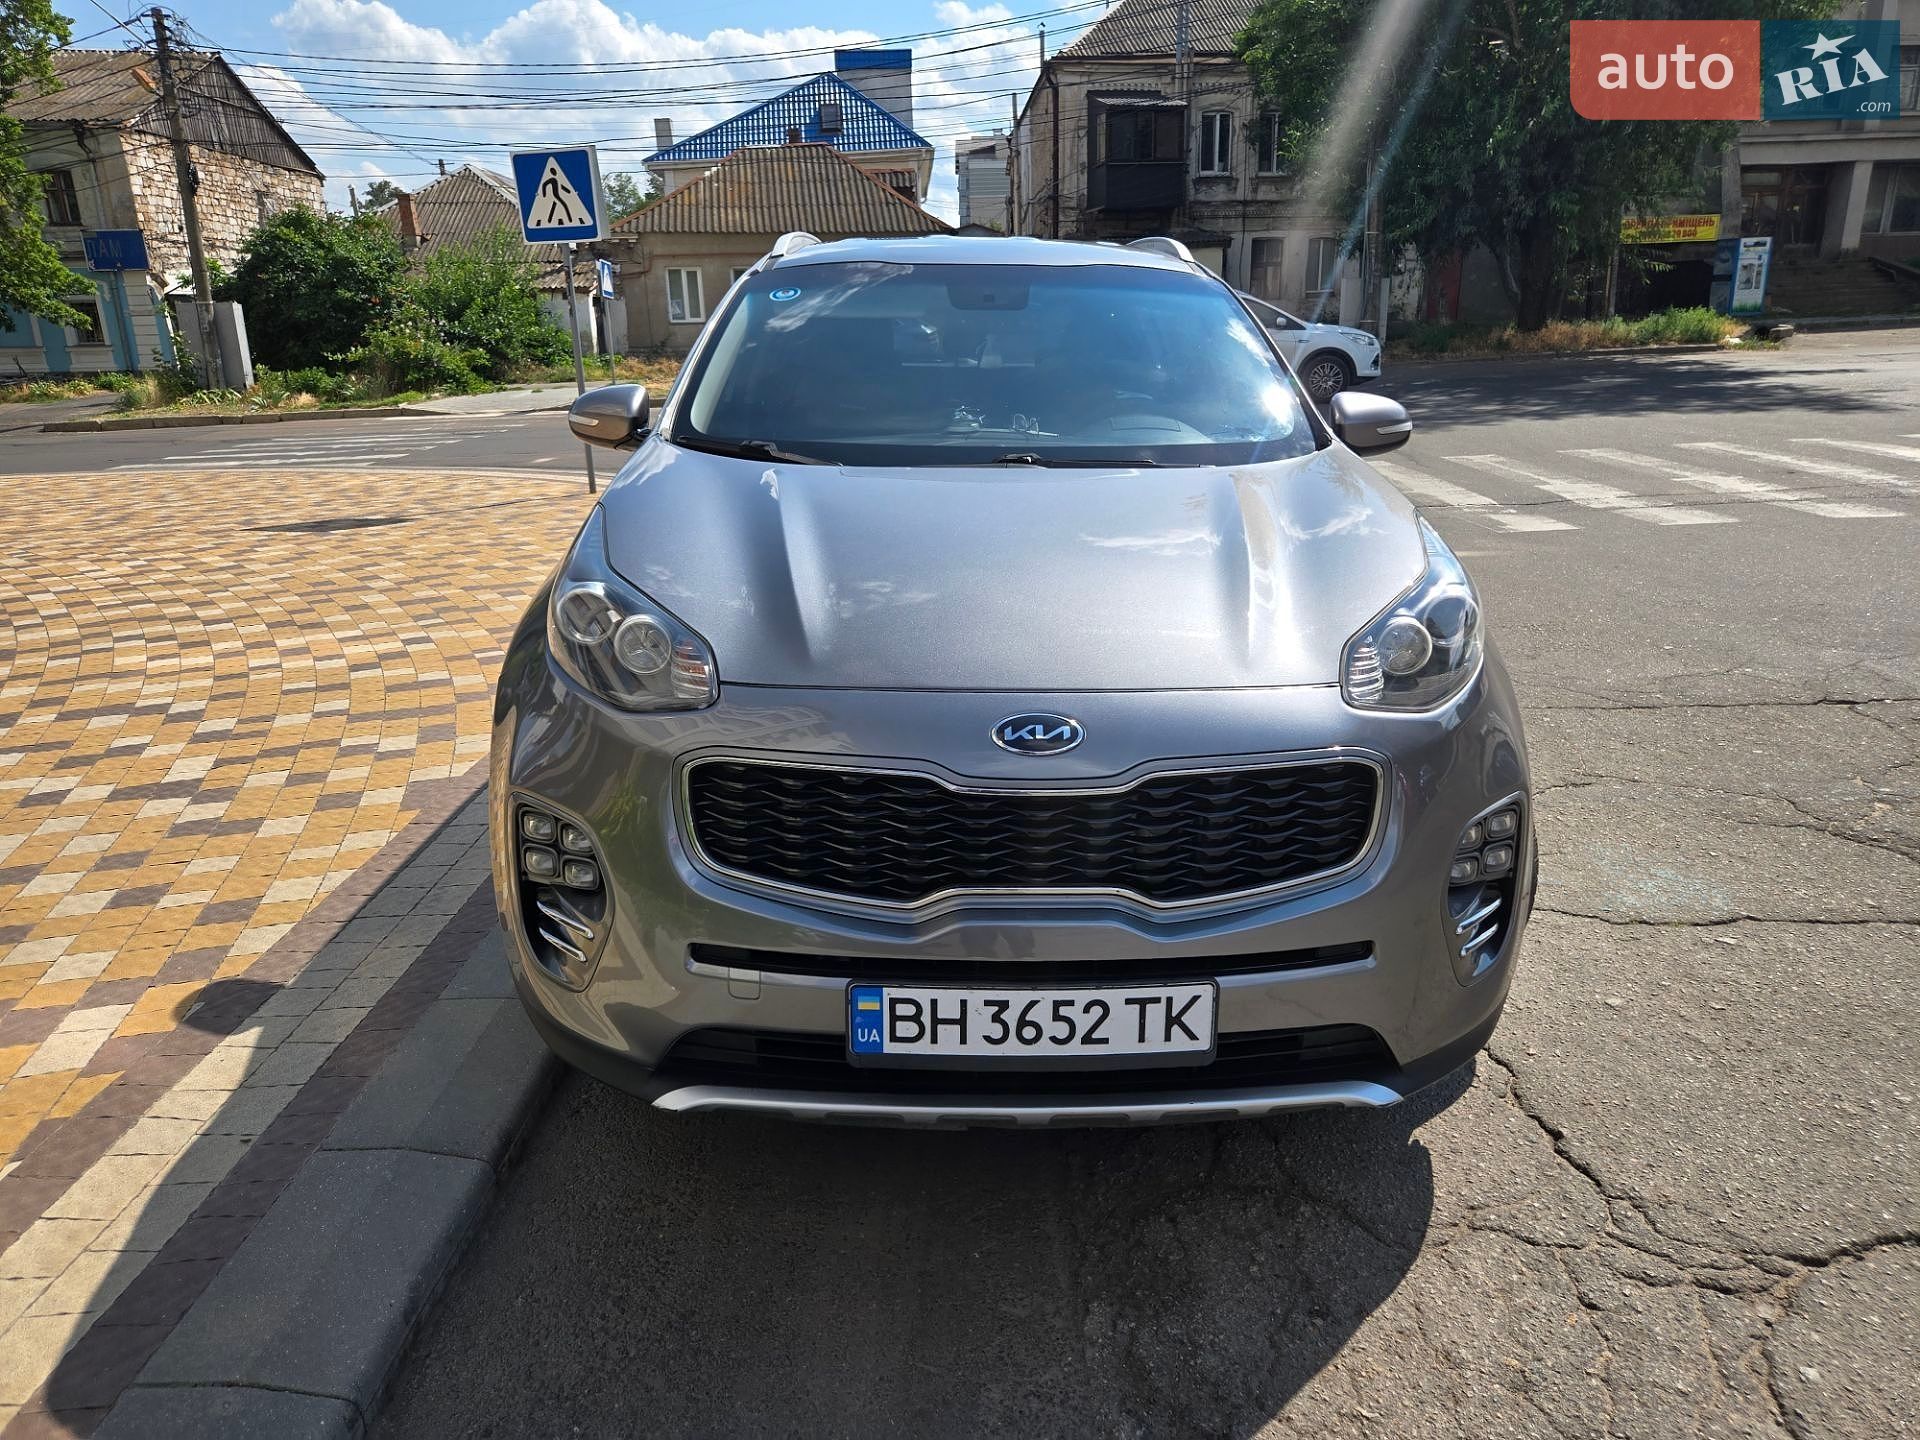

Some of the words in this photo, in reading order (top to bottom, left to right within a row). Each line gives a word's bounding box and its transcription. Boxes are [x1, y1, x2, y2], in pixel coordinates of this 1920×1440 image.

[1004, 724, 1071, 741] KIA
[858, 1027, 880, 1043] UA
[888, 997, 968, 1045] BH
[981, 999, 1111, 1046] 3652
[1125, 994, 1203, 1043] TK
